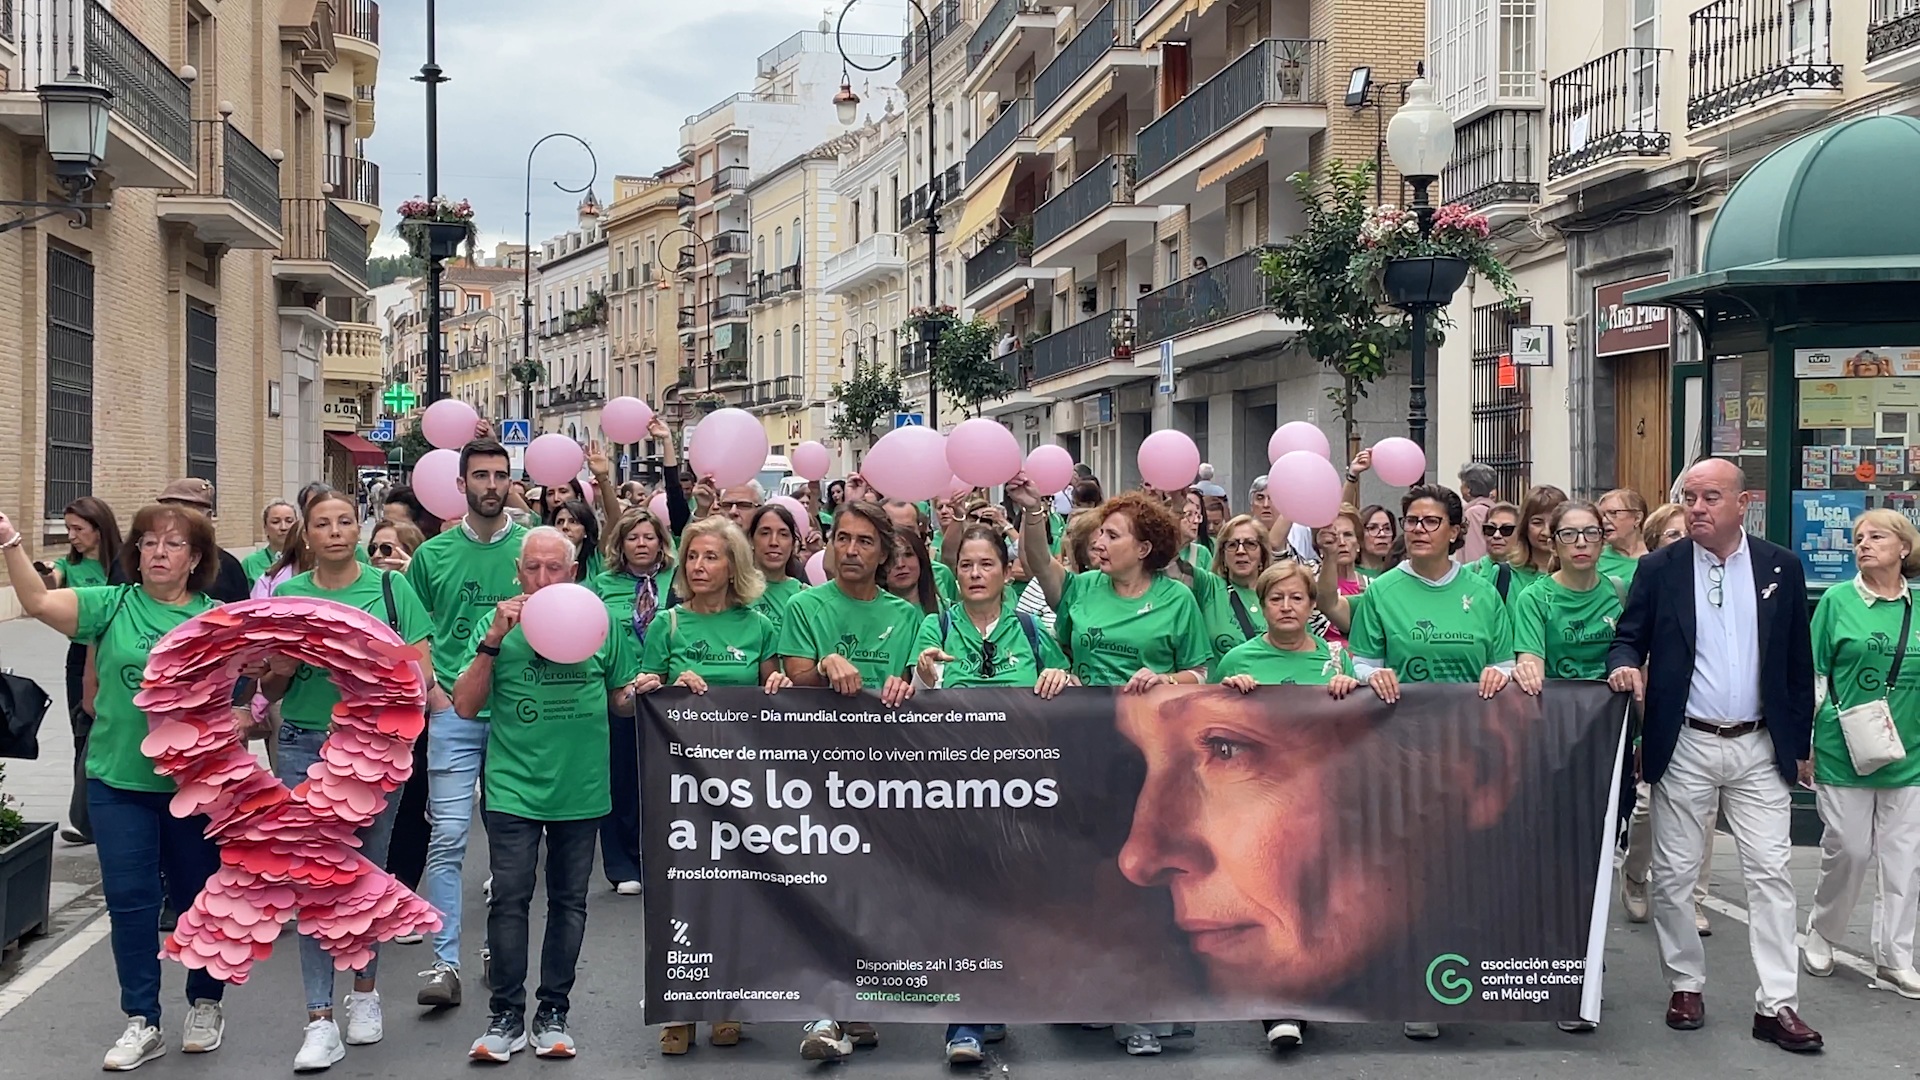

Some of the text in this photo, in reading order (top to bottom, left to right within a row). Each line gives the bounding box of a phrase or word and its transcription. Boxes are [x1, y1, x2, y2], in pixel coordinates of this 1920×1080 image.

[1609, 304, 1635, 330] Ana
[1807, 507, 1850, 521] RASCA
[667, 709, 681, 721] 19
[683, 709, 698, 721] de
[700, 710, 749, 722] octubre
[760, 710, 781, 722] Día
[784, 710, 837, 722] mundial
[839, 711, 881, 723] contra
[884, 711, 897, 723] el
[899, 710, 943, 722] cáncer
[945, 710, 962, 722] de
[965, 711, 1006, 722] mama
[669, 742, 1061, 764] El cáncer de mama y cómo lo viven miles de personas
[670, 769, 1059, 809] nos lo tomamos
[667, 815, 871, 860] a pecho.
[667, 867, 828, 886] #noslotomamosapecho
[667, 951, 713, 964] Bizum
[1481, 958, 1549, 970] asociación
[856, 959, 923, 972] Disponibles
[925, 959, 946, 972] 24h
[955, 959, 976, 971] 365
[667, 966, 710, 981] 06491
[1481, 972, 1584, 985] contra el cáncer
[856, 976, 928, 988] 900 100 036
[663, 988, 800, 1001] dona.contraelcancer.es
[856, 991, 961, 1002] contraelcancer.es
[1482, 988, 1549, 1002] en Málaga
